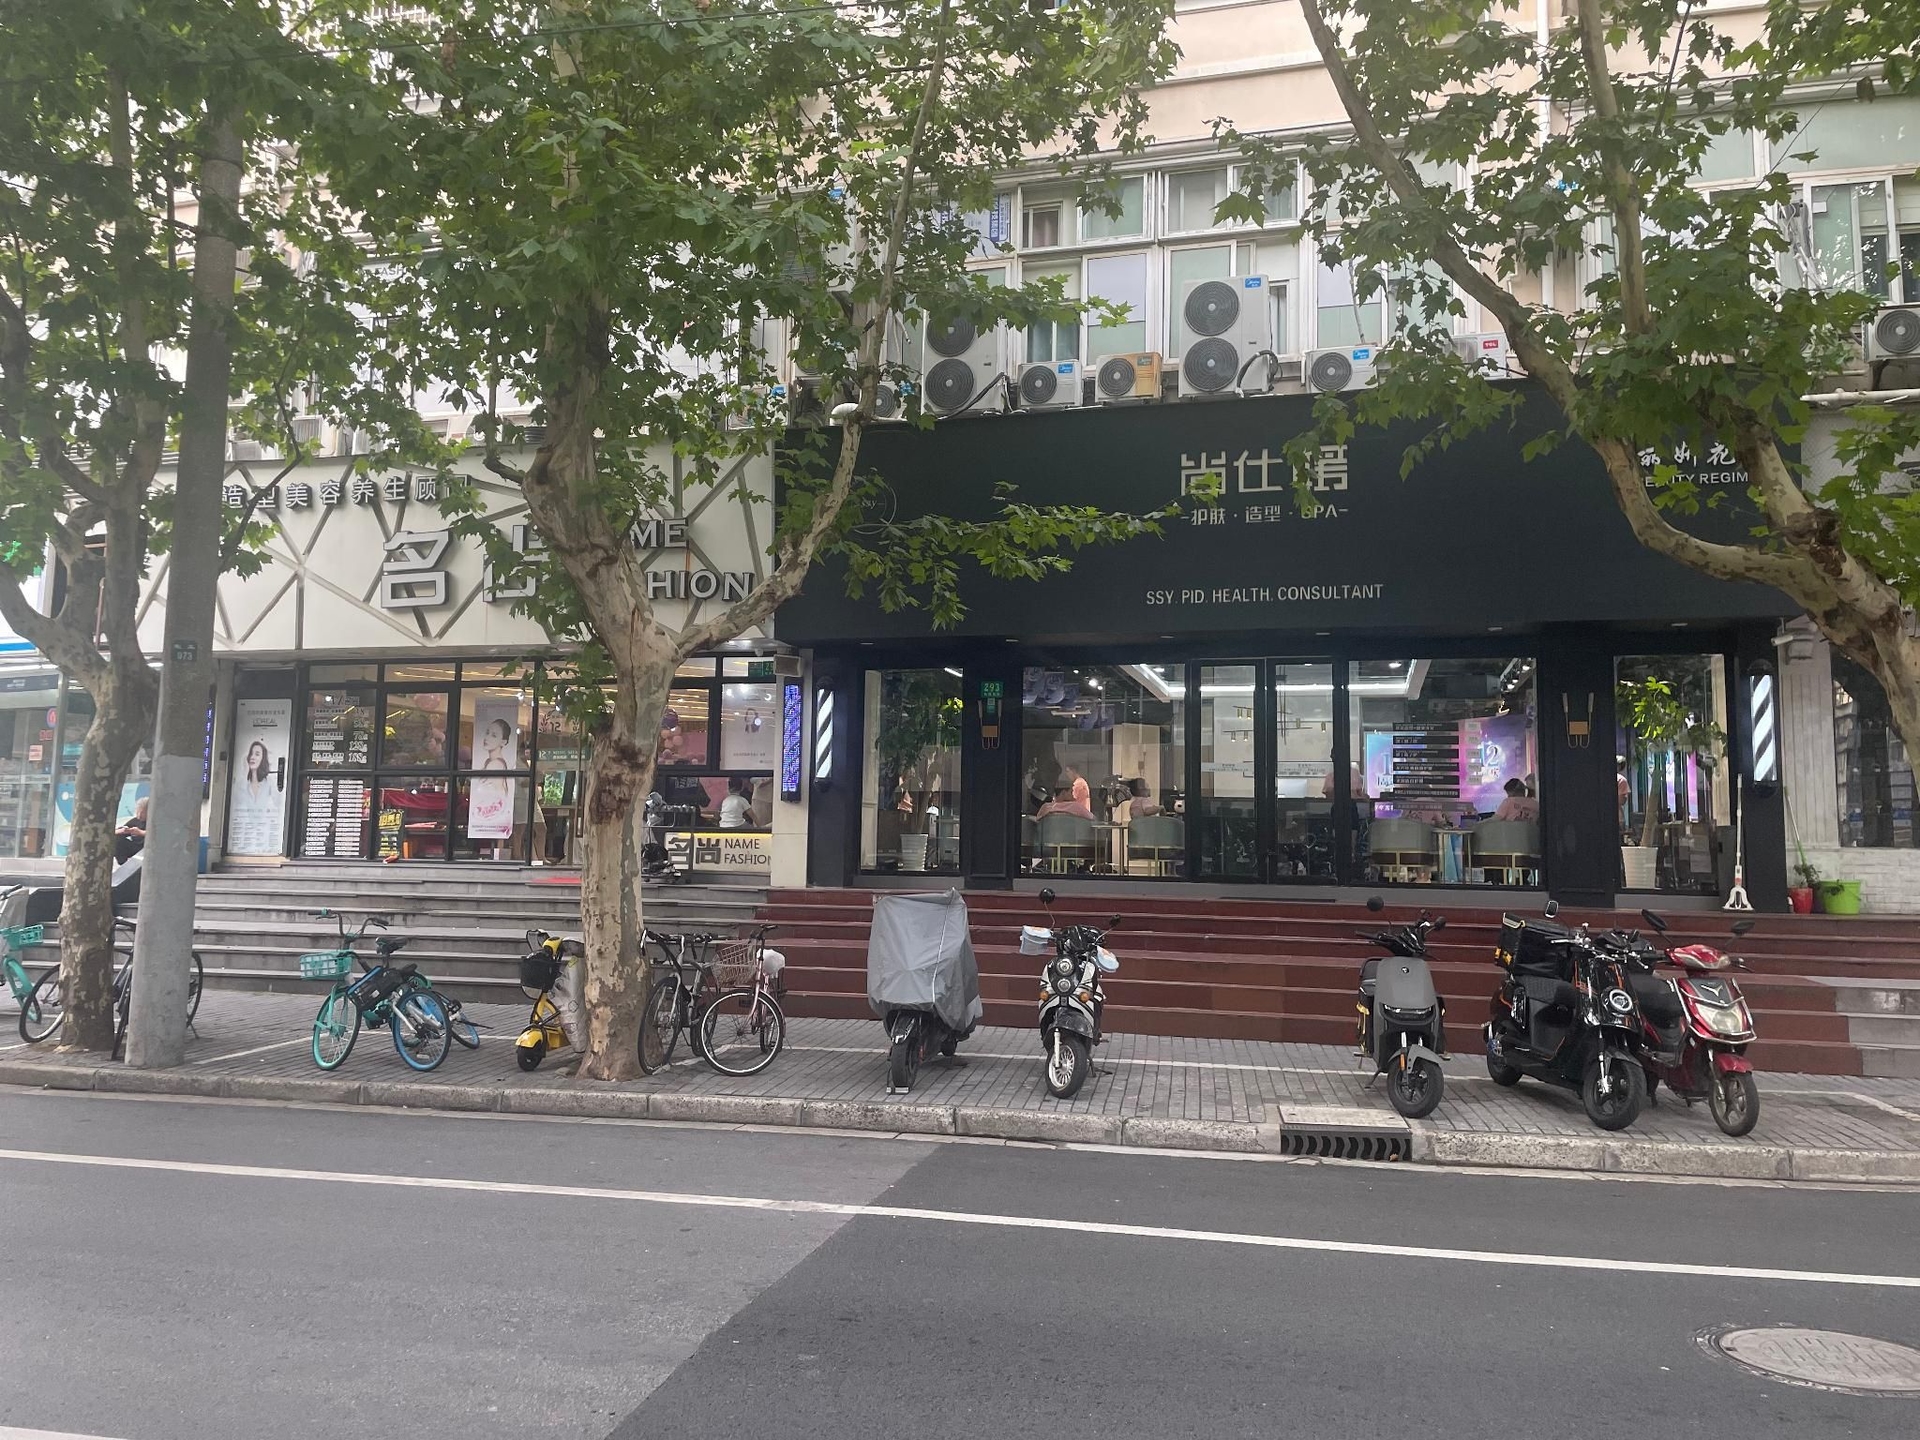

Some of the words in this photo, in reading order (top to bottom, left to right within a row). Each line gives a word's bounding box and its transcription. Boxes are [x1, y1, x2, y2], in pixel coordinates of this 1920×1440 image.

[1699, 471, 1749, 485] REGIM
[631, 518, 690, 549] ME
[646, 570, 754, 601] HION
[1277, 584, 1384, 601] CONSULTANT
[983, 682, 1000, 692] 293
[724, 838, 760, 850] NAME
